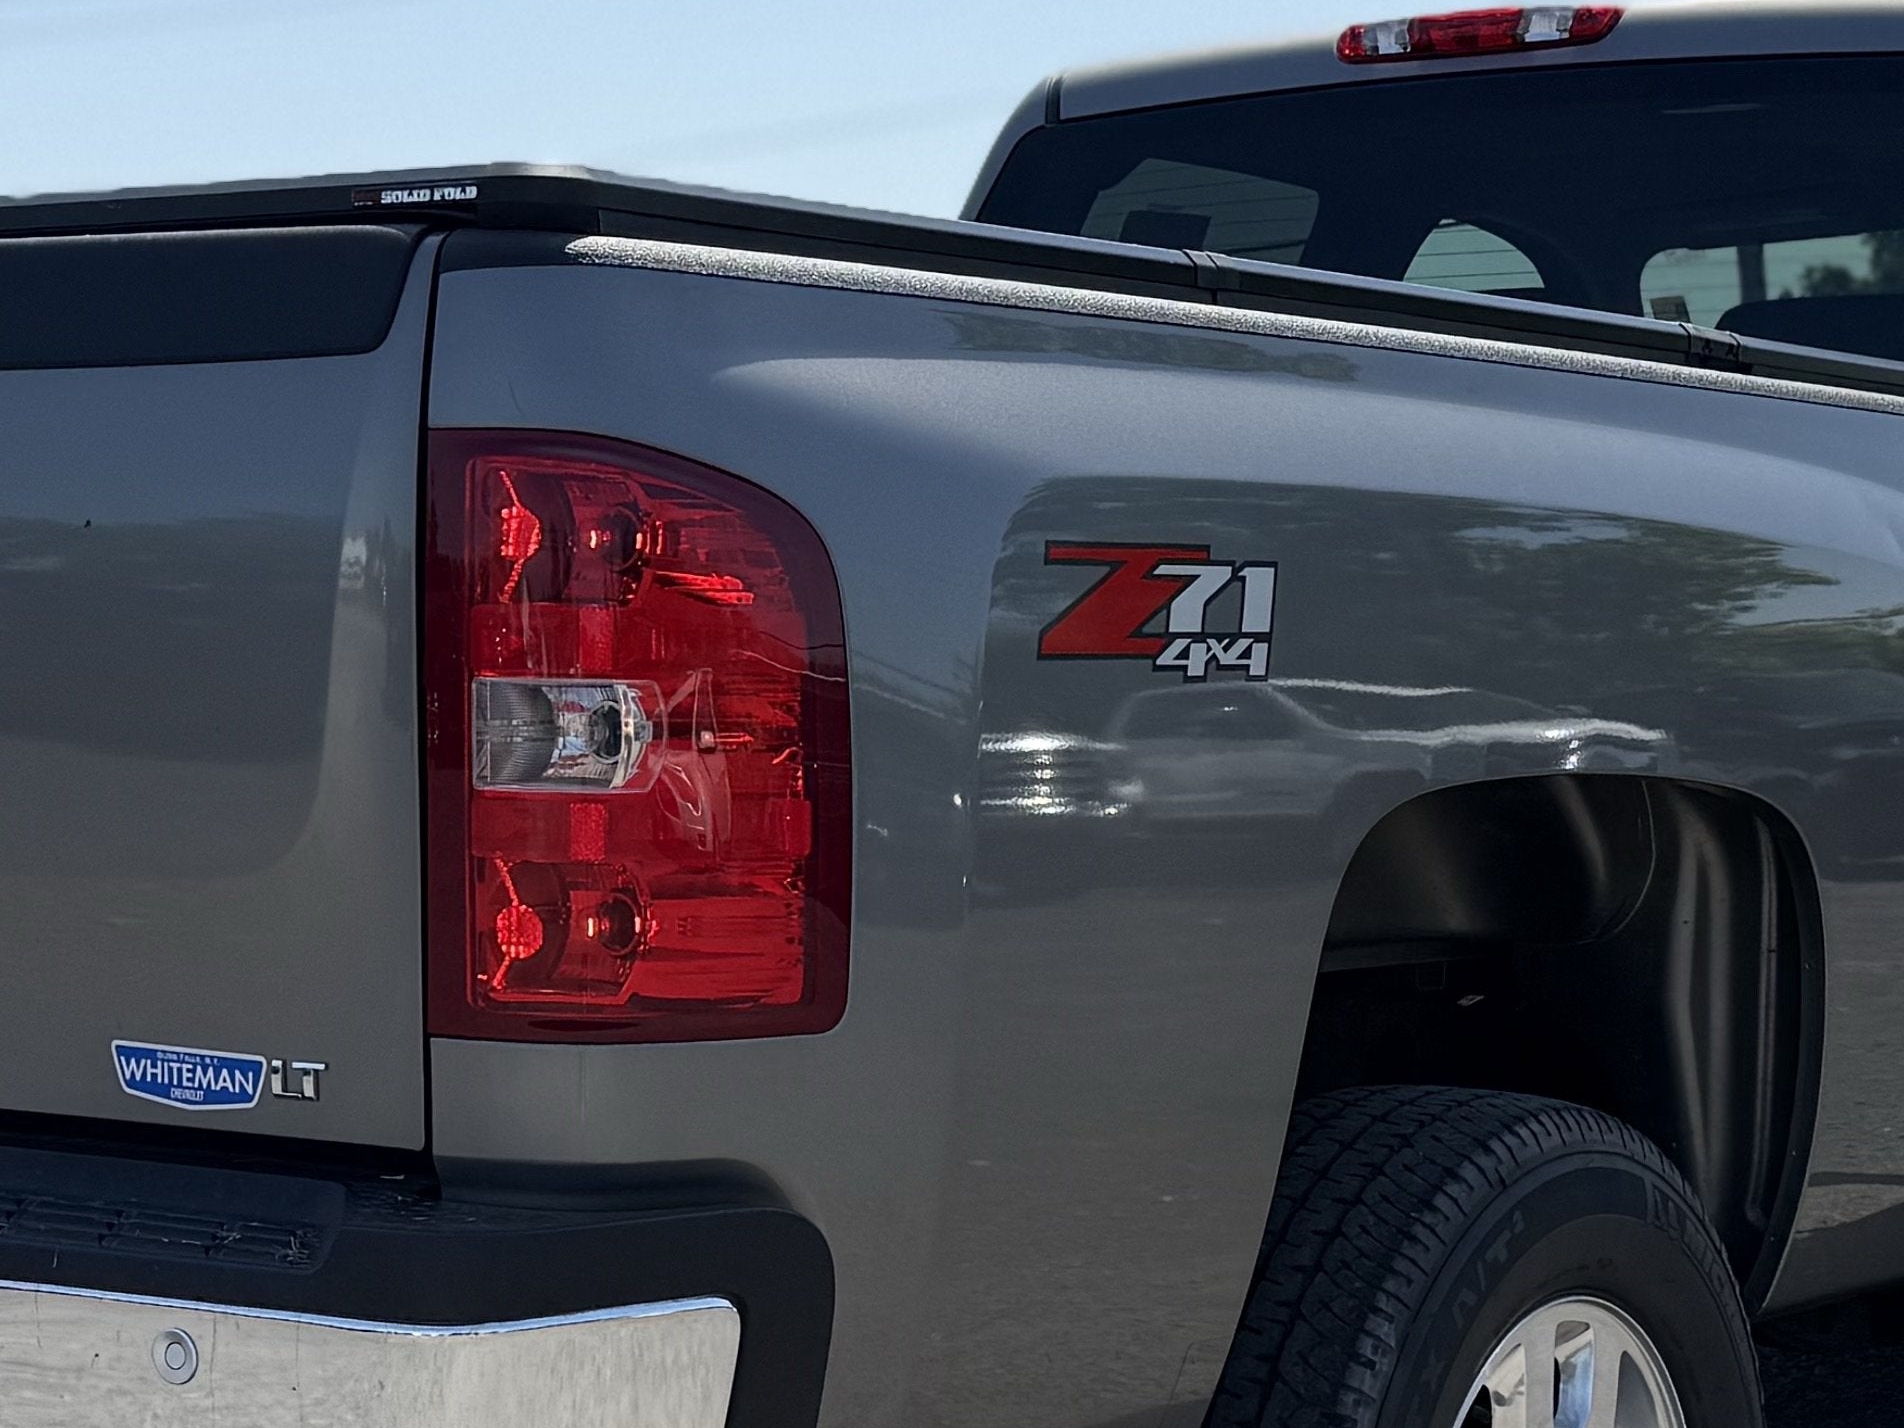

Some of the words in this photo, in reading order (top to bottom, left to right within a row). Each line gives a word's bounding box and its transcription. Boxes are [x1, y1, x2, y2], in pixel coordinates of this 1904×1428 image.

[380, 189, 431, 204] SOLID
[433, 186, 478, 201] FOLD
[1037, 540, 1278, 661] Z71
[119, 1055, 254, 1095] WHITEMAN
[271, 1059, 327, 1100] LT
